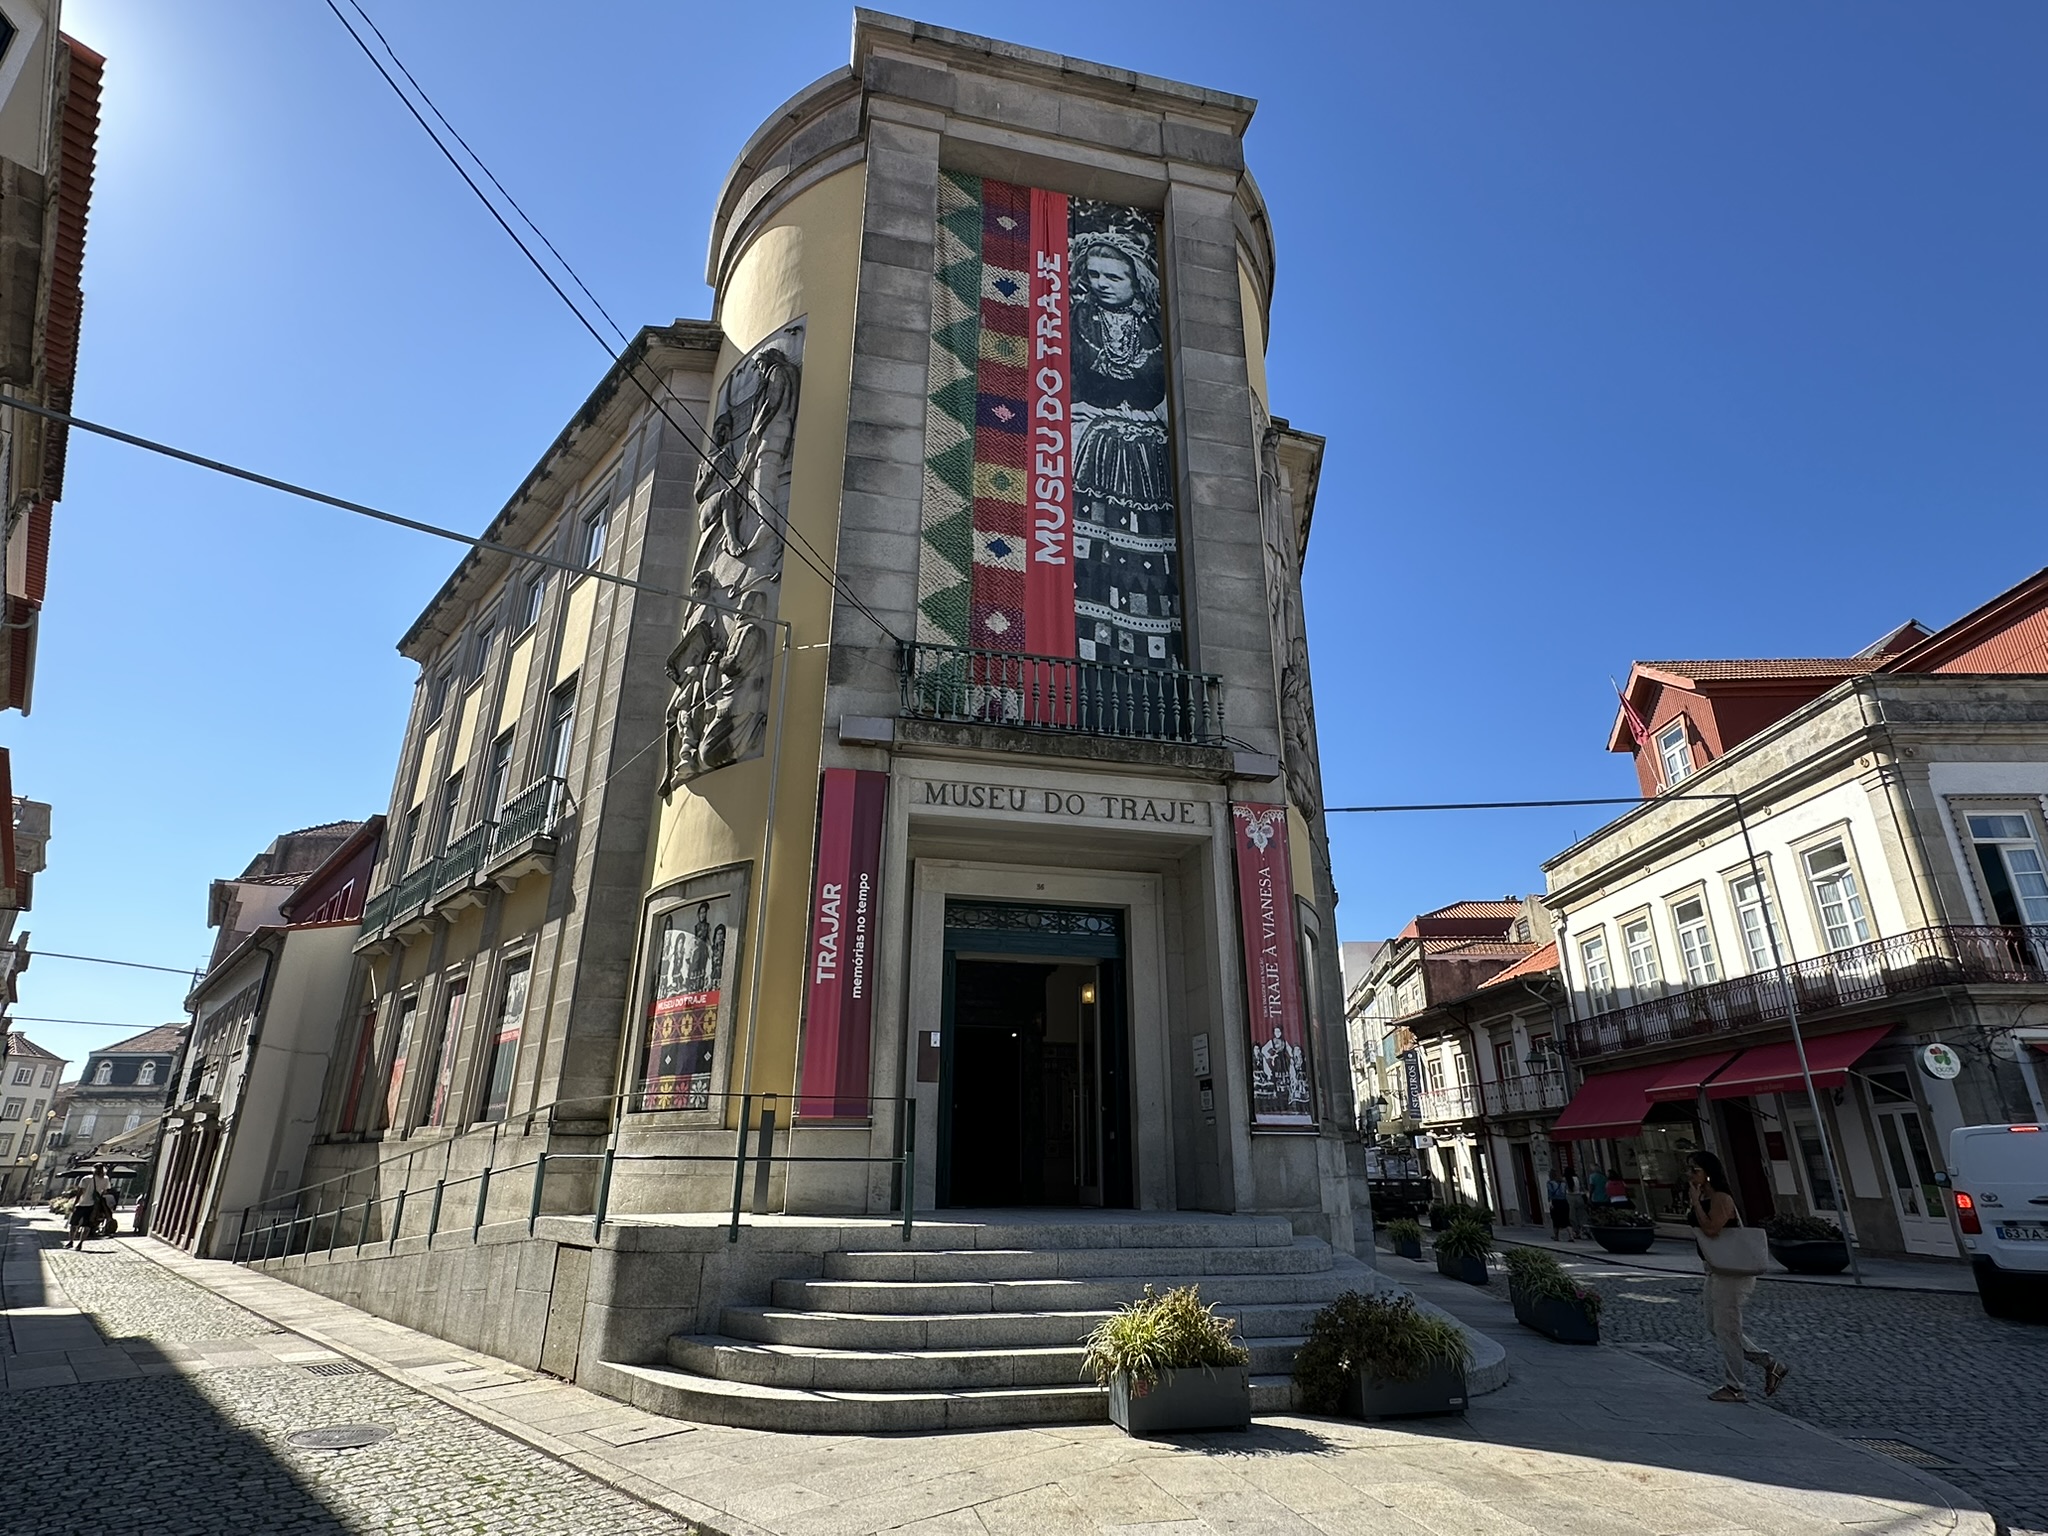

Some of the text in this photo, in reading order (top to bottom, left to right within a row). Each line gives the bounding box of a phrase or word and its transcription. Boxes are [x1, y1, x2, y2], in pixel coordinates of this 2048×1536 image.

[1035, 250, 1066, 566] MUSEU DO TRAJE
[924, 781, 1197, 824] MUSEU DO TRAJE
[816, 883, 842, 985] TRAJAR
[851, 872, 870, 999] memórias no tempo
[1258, 867, 1282, 1018] TRAJE À VIANESA
[658, 994, 708, 1010] MUSEU DO TRAJE
[1407, 1065, 1420, 1108] SEGUROS
